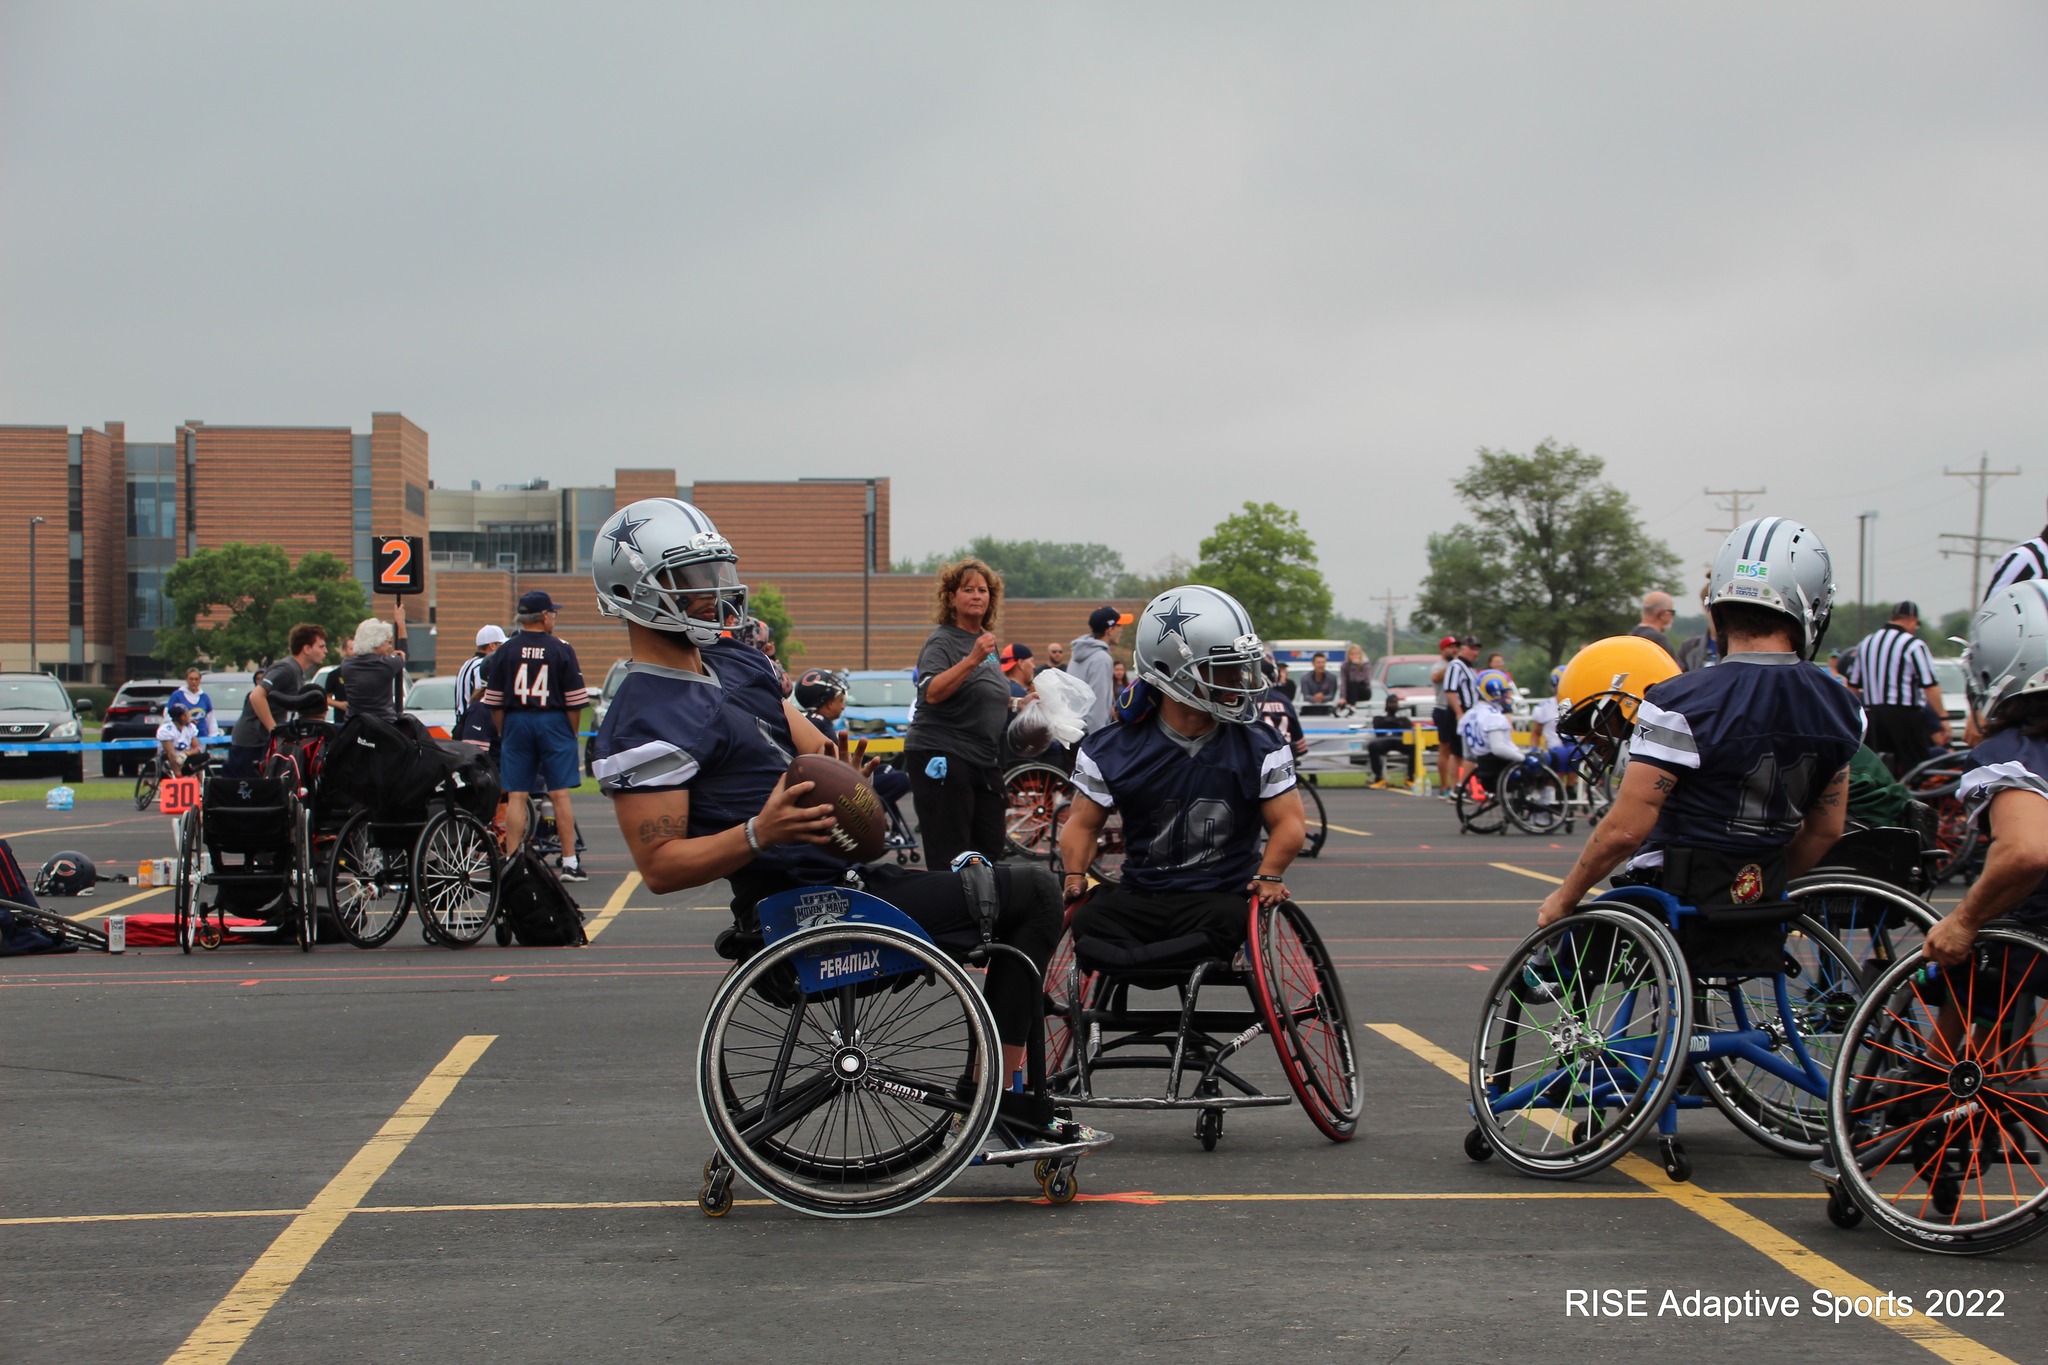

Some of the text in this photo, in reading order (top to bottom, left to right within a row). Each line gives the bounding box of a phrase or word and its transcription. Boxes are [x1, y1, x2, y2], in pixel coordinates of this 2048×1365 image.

[381, 539, 412, 584] 2
[1737, 562, 1768, 578] RISE
[521, 646, 546, 660] SFIRE
[513, 662, 550, 707] 44
[165, 782, 194, 809] 30
[800, 889, 841, 906] UTA
[826, 901, 849, 915] MAVS
[820, 949, 880, 980] PER4MAX
